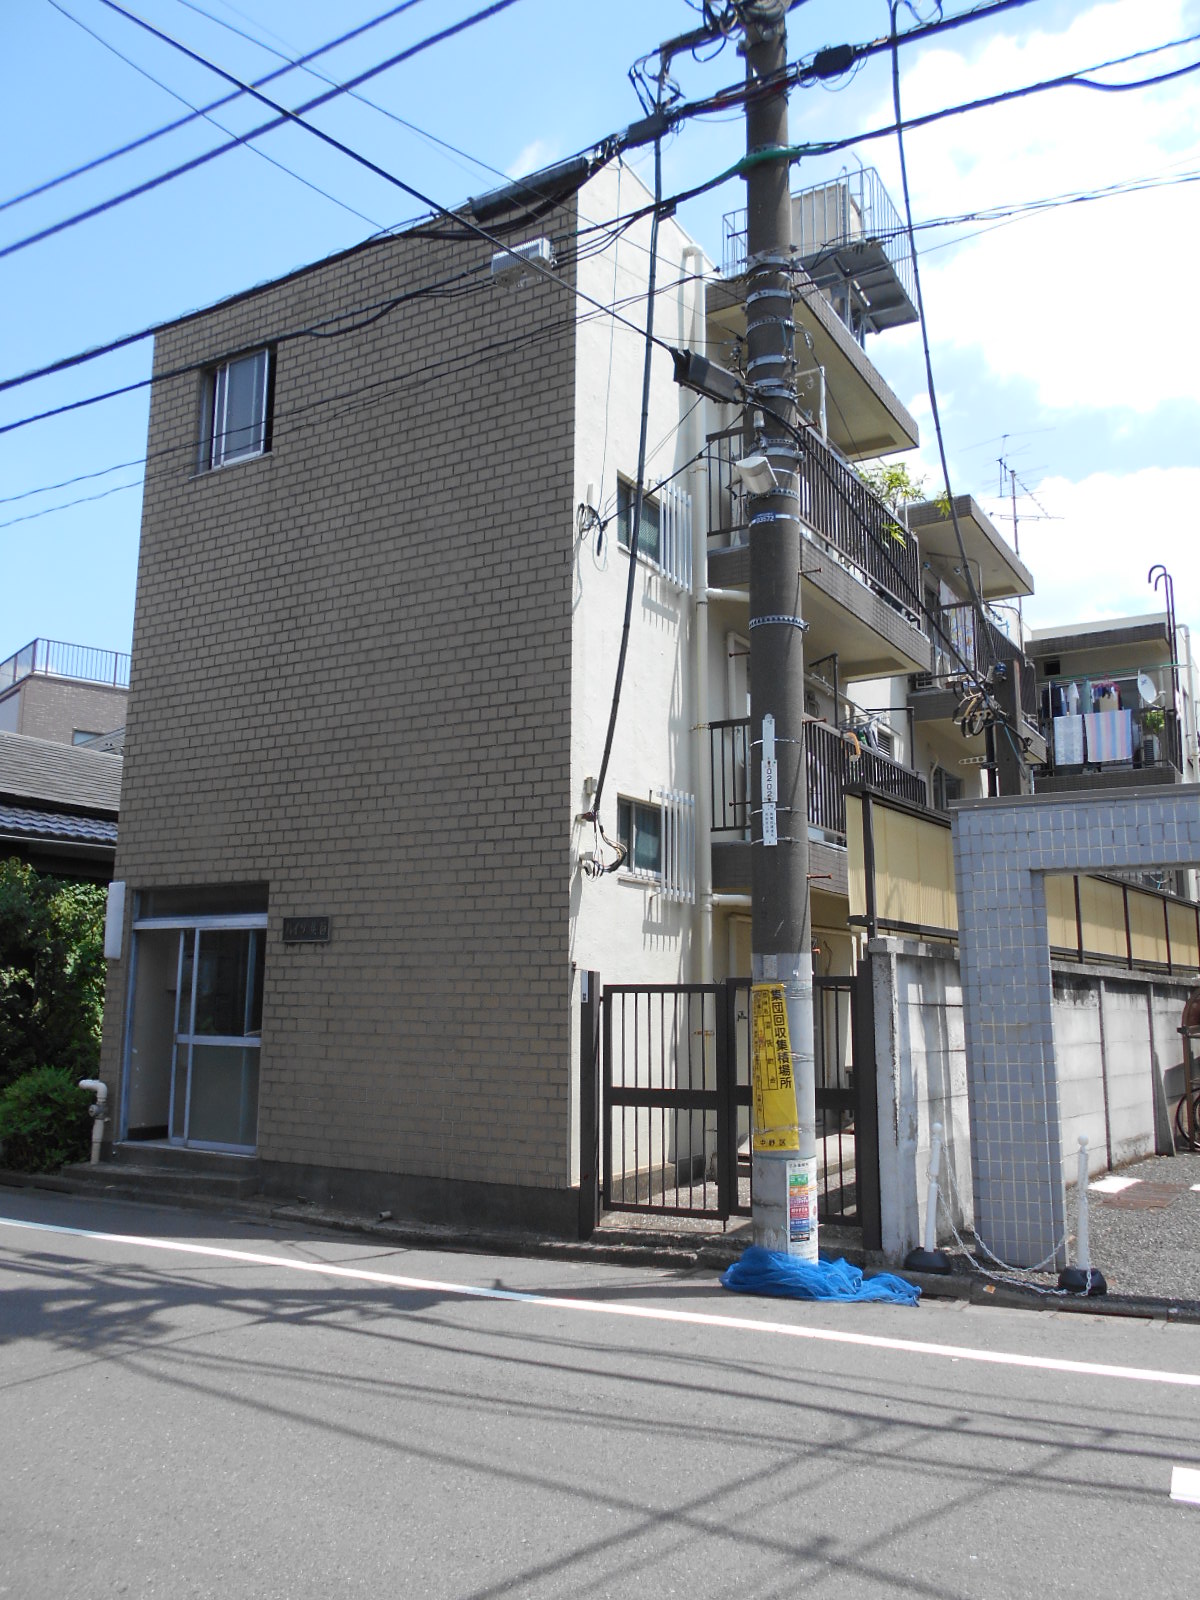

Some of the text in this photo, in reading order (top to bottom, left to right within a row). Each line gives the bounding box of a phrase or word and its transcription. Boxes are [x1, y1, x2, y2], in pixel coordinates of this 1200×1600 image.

[770, 989, 792, 1090] 集団回収集積場所
[760, 1138, 786, 1147] 中野区
